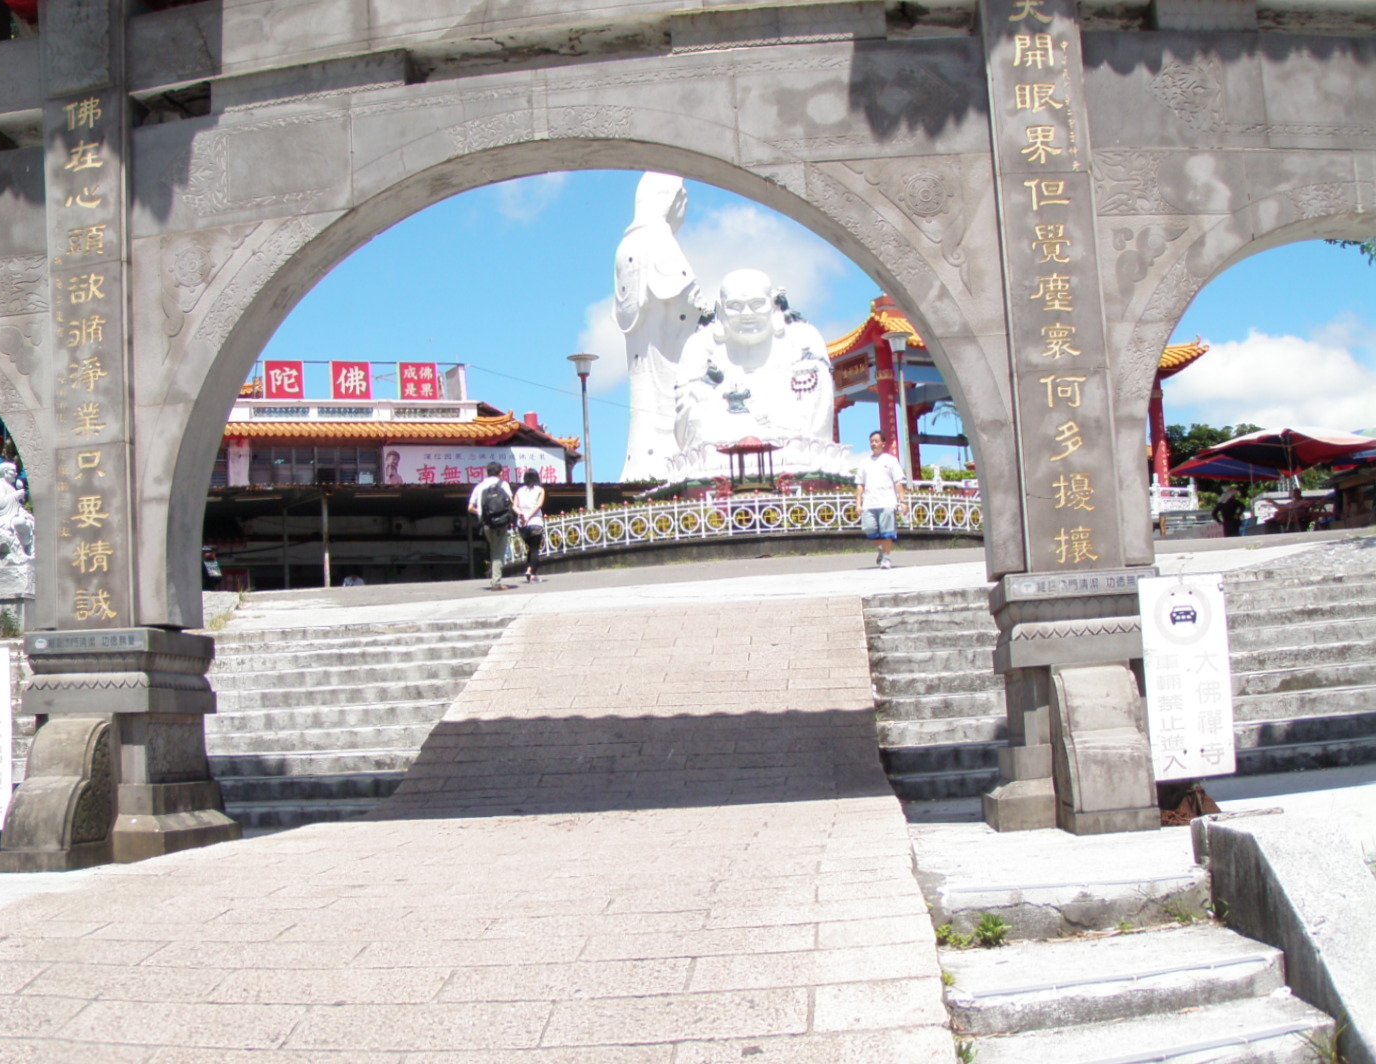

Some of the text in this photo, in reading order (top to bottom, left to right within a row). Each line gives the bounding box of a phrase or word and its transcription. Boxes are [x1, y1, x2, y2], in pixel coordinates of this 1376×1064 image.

[270, 366, 299, 393] 陀
[336, 366, 368, 395] 佛
[1193, 650, 1224, 765] 大佛禪寺
